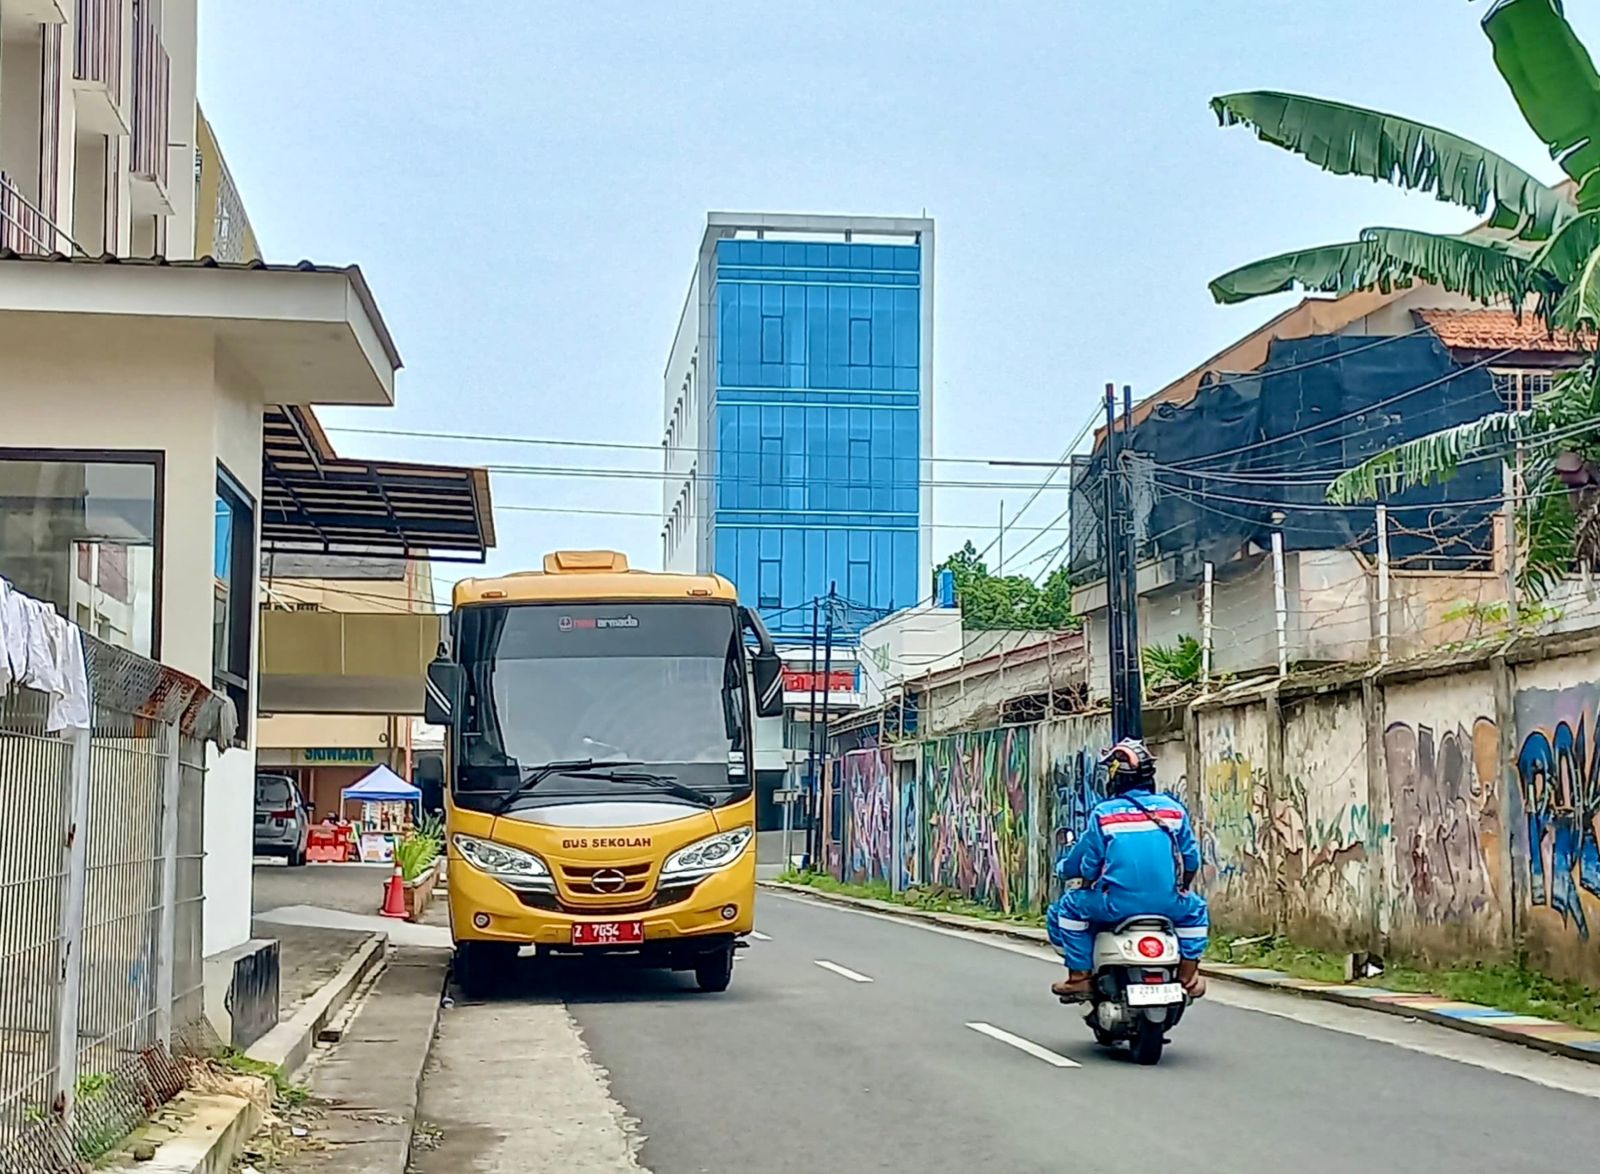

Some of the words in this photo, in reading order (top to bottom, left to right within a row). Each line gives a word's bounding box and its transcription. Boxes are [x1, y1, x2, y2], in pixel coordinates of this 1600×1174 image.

[562, 839, 587, 849] BUS
[591, 838, 651, 848] SEKOLAH
[574, 925, 582, 937] Z
[632, 922, 640, 935] X
